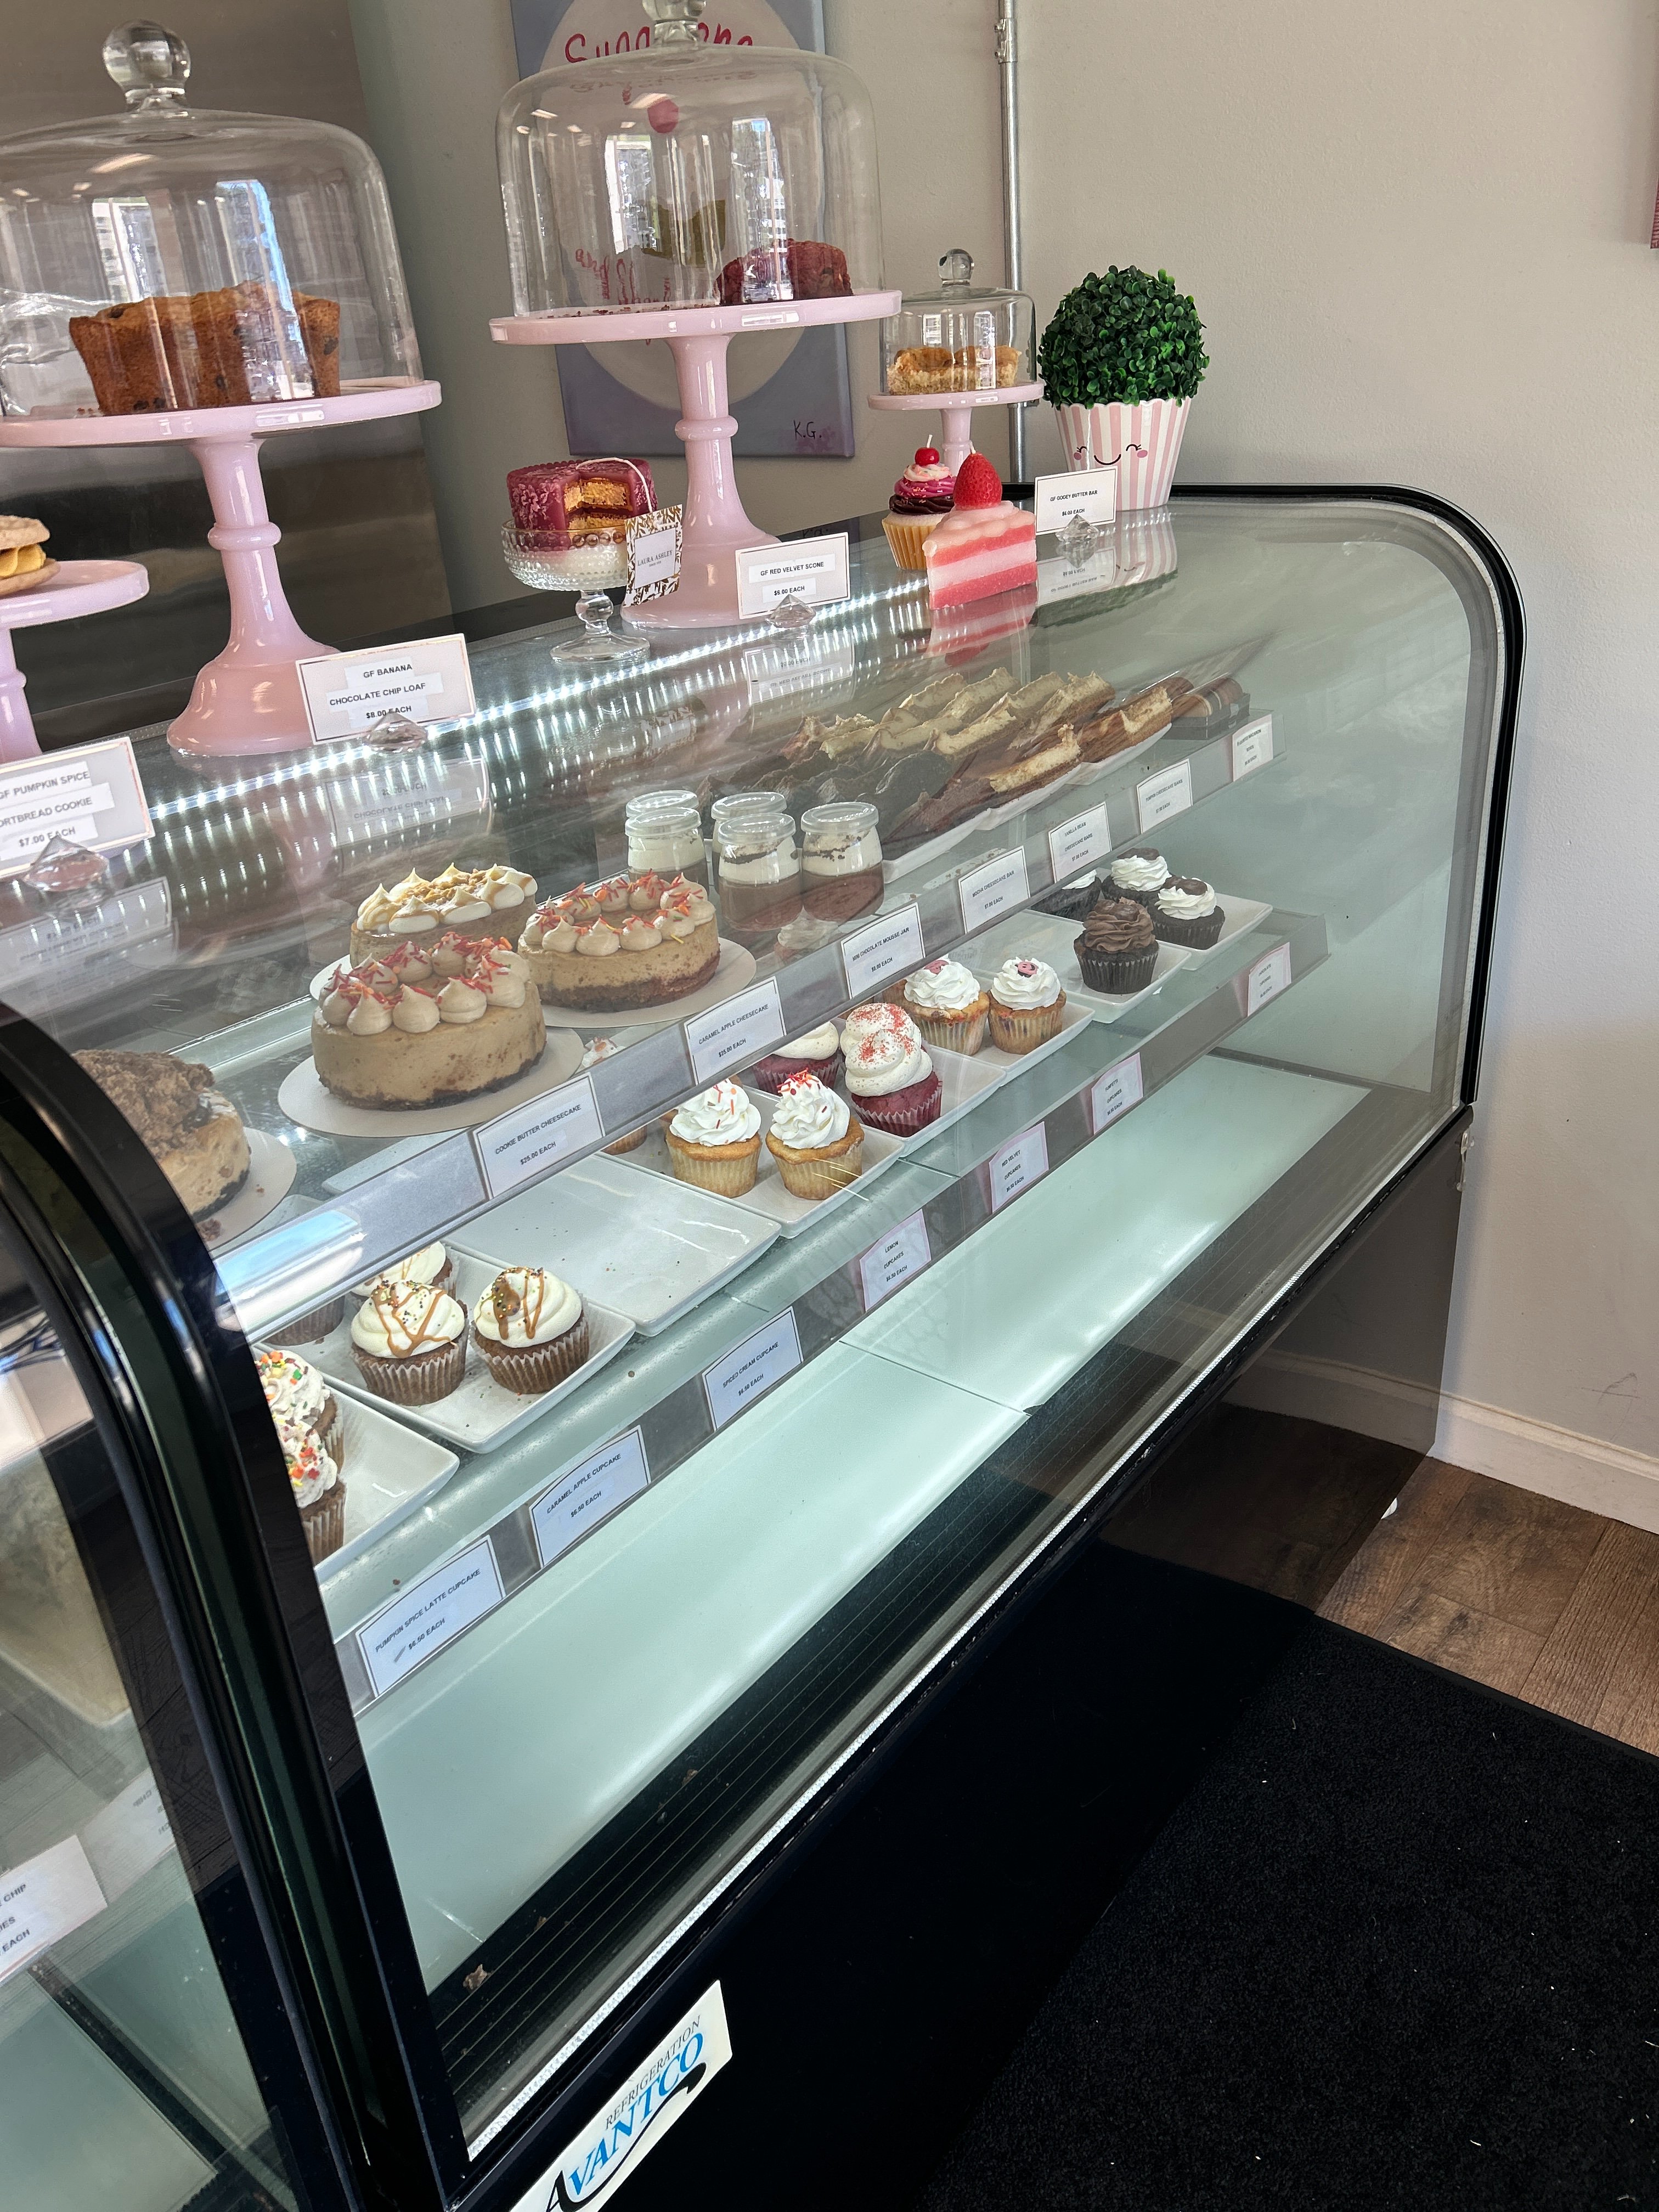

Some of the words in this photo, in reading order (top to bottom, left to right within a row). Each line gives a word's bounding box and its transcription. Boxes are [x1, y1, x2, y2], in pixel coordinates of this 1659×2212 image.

[637, 556, 654, 567] LAURA
[655, 550, 673, 560] ASHLEY
[377, 664, 413, 676] BANANA
[330, 691, 381, 706] CHOCOLATE
[382, 687, 402, 696] CHIP
[404, 683, 426, 692] LOAF
[388, 706, 412, 714] EACH
[13, 778, 58, 795] PUMPKIN
[61, 771, 90, 784] SPICE
[55, 797, 93, 812] COOKIE
[19, 835, 45, 847] $7.00
[48, 827, 76, 839] EACH
[984, 875, 1006, 890] CHEESECAKE
[860, 940, 882, 957] CHOCOLATE
[883, 932, 900, 944] MOUSSE
[882, 957, 893, 966] EACH
[699, 1030, 720, 1044] CARAMEL
[721, 1020, 736, 1032] APPLE
[736, 1004, 769, 1023] CHEESECAKE
[718, 1046, 732, 1058] $25.00
[733, 1039, 746, 1049] EACH
[1107, 1089, 1122, 1103] CUPCAKES
[1114, 1102, 1122, 1110] EACH
[495, 1138, 516, 1154] COOKIE
[517, 1125, 540, 1141] BUTTER
[541, 1104, 582, 1128] CHEESECAKE
[521, 1151, 538, 1165] $25.00
[539, 1142, 556, 1154] EACH
[1008, 1150, 1021, 1162] VELVET
[1004, 1164, 1021, 1180] CUPCAKES
[1014, 1176, 1024, 1186] EACH
[885, 1240, 899, 1253] LEMON
[884, 1251, 904, 1269] CUPCAKES
[896, 1265, 907, 1275] EACH
[723, 1372, 738, 1388] SPICED
[739, 1358, 756, 1374] CREAM
[756, 1341, 779, 1361] CUPCAKE
[751, 1374, 764, 1386] EACH
[547, 1489, 572, 1514] CARAMEL
[573, 1472, 591, 1491] APPLE
[592, 1453, 622, 1475] CUPCAKE
[585, 1491, 602, 1506] EACH
[375, 1625, 404, 1652] PUMPKIN
[404, 1609, 424, 1627] SPICE
[425, 1592, 447, 1612] LATTE
[448, 1568, 481, 1594] CUPCAKE
[408, 1634, 425, 1650] $6.50
[426, 1618, 445, 1636] EACH
[4, 1883, 26, 1903] CHIP
[3, 1929, 30, 1953] EACH
[605, 2015, 701, 2130] REFRIGERATION
